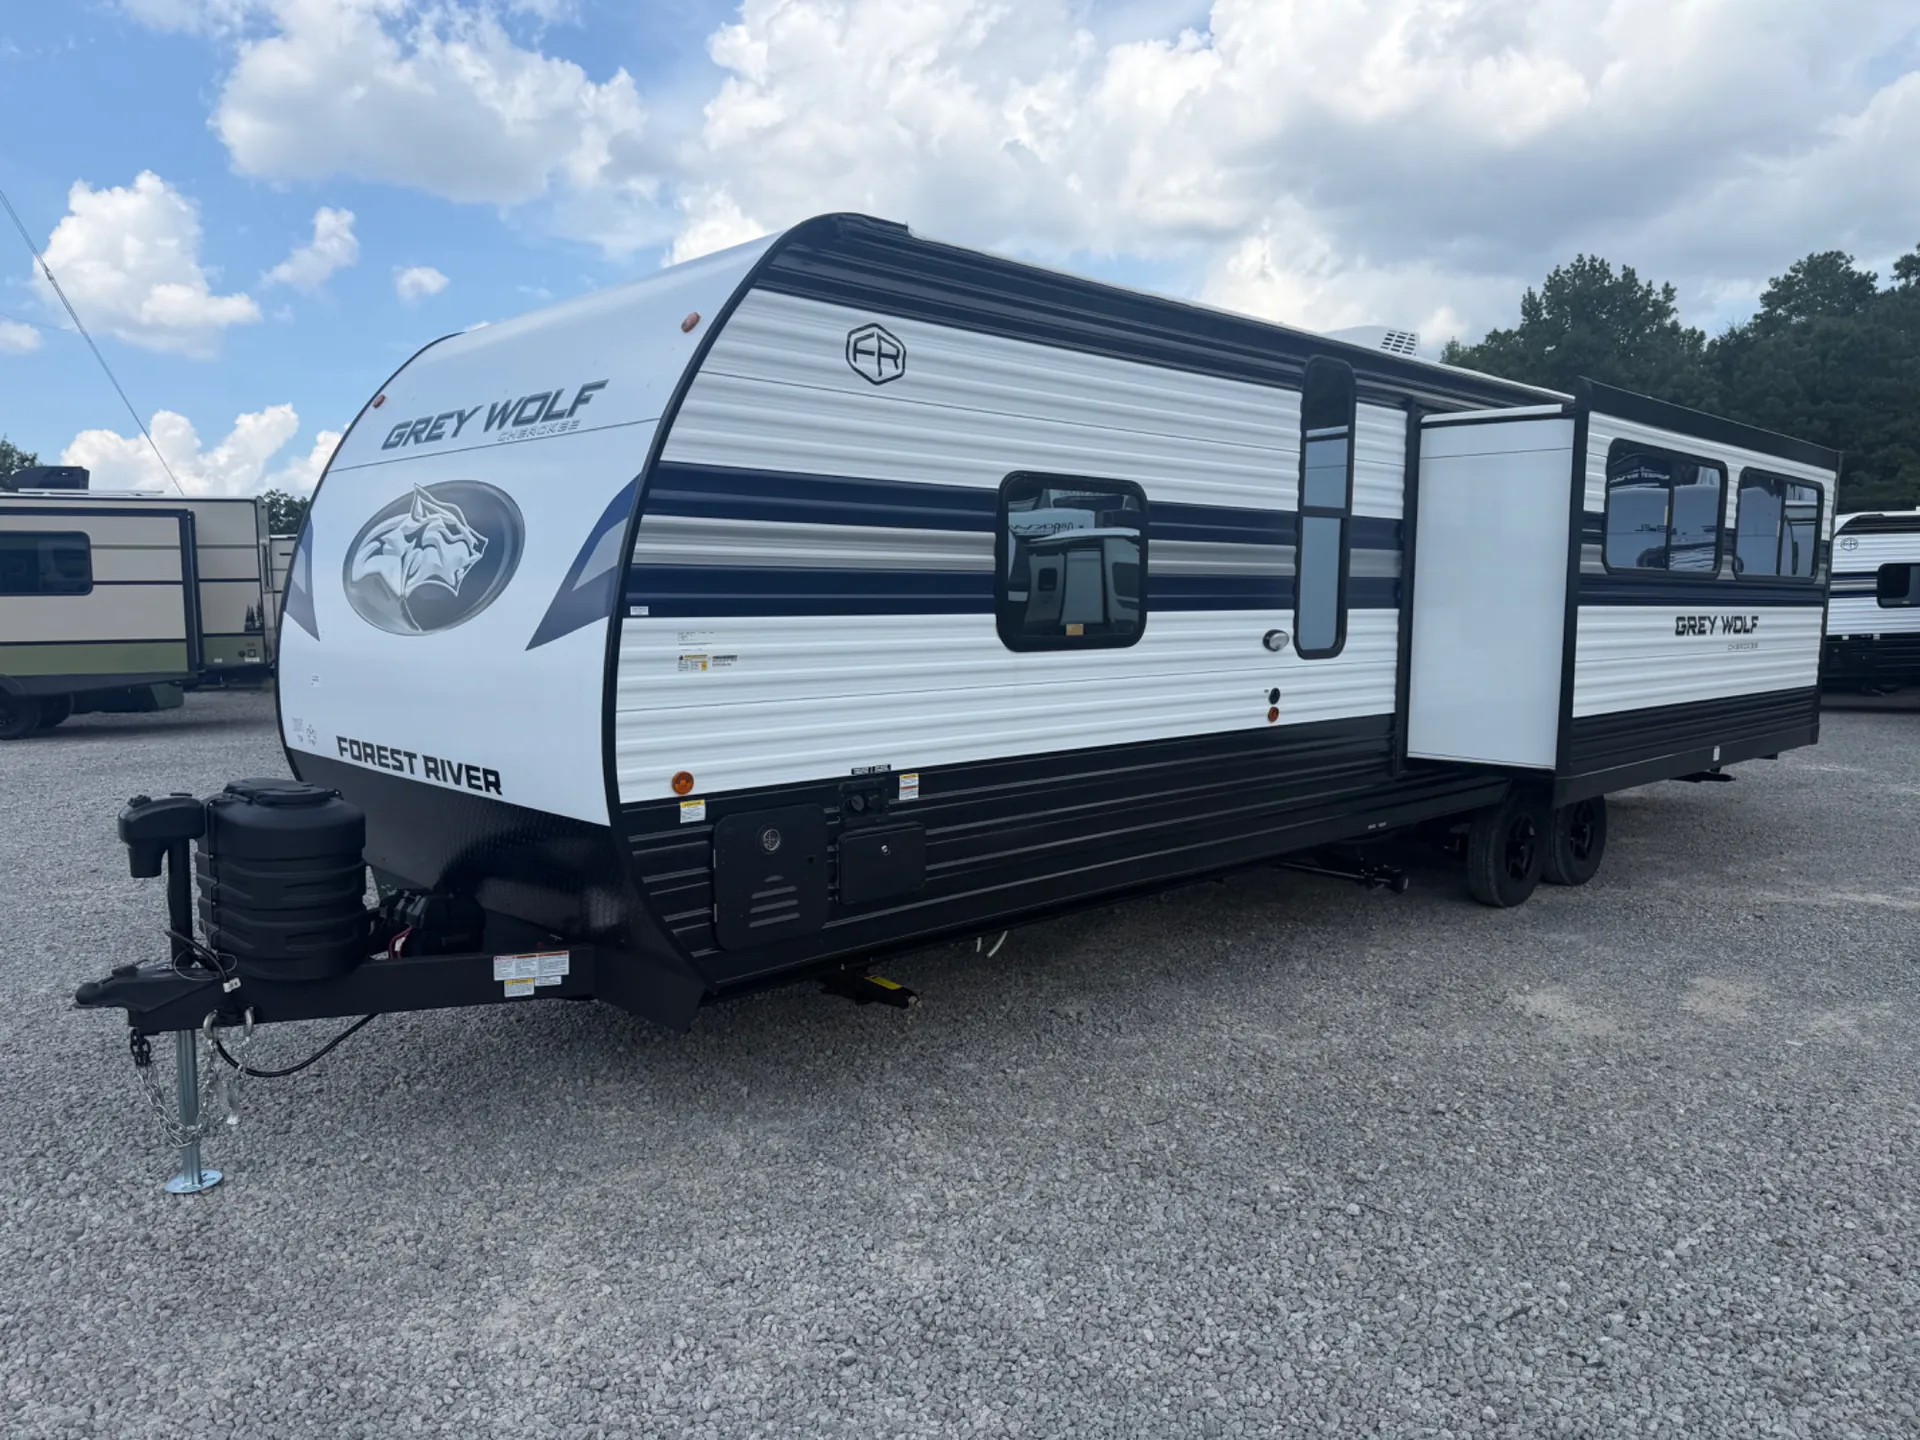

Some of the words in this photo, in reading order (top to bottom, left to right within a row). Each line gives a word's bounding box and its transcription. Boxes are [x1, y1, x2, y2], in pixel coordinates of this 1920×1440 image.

[381, 404, 484, 451] GREY
[483, 379, 610, 433] WOLF
[1674, 615, 1718, 637] GREY
[1721, 615, 1760, 635] WOLF
[336, 735, 417, 775] FOREST
[422, 754, 503, 796] RIVER
